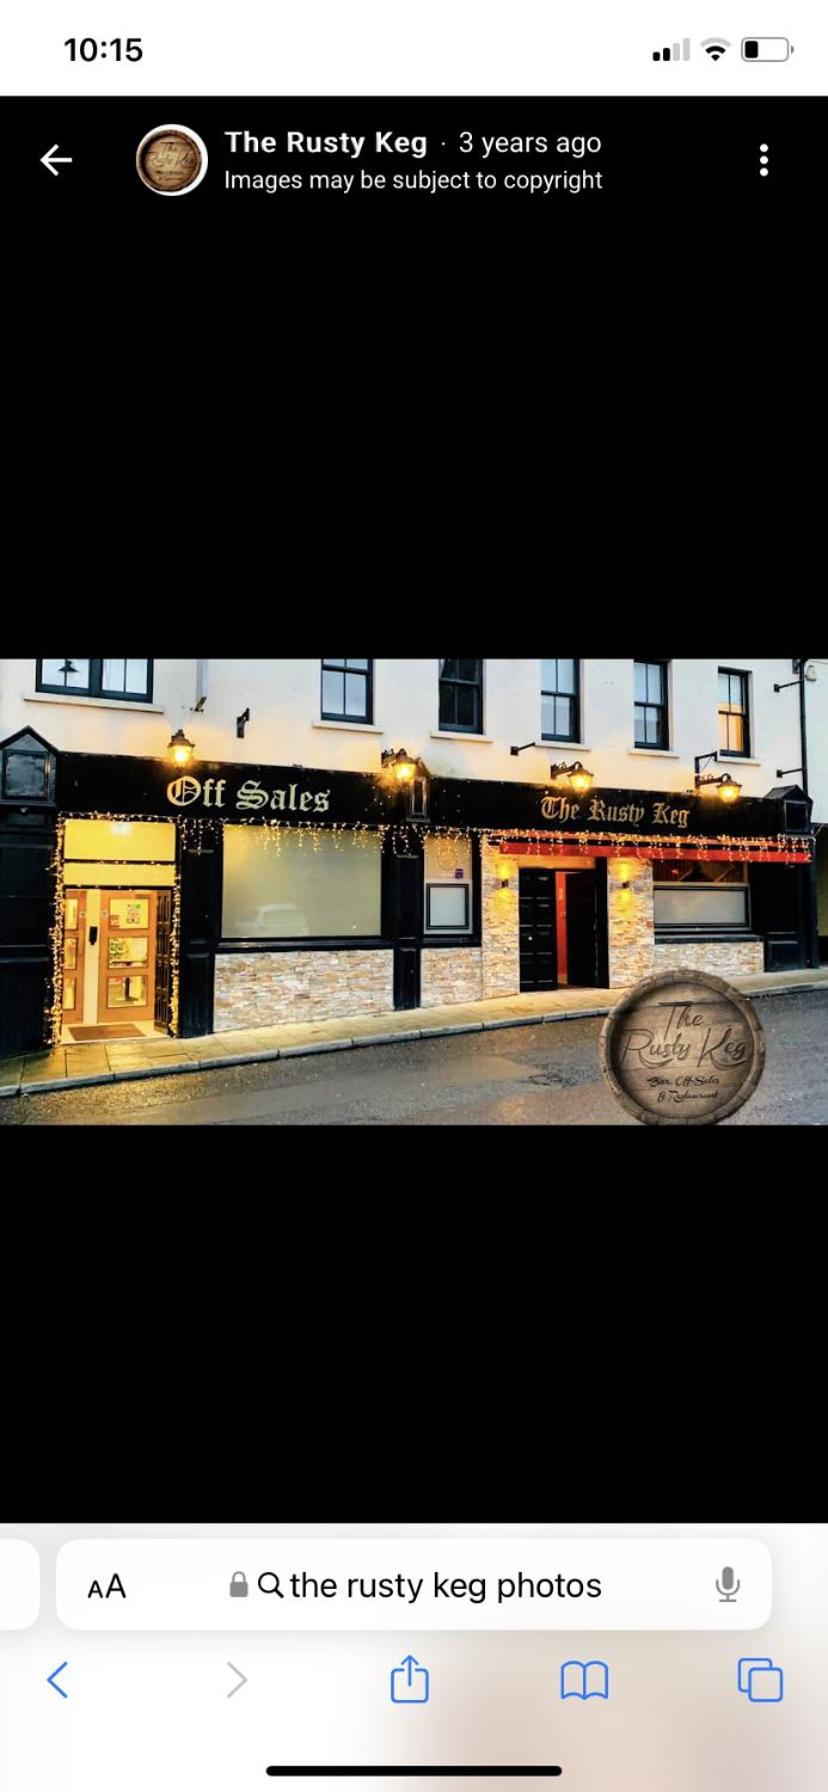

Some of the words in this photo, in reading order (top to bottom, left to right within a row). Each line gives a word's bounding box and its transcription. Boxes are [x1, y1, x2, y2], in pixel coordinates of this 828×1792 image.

[64, 37, 143, 63] 10:15
[223, 130, 277, 154] The
[287, 131, 366, 159] Rusty
[375, 131, 427, 159] Keg
[459, 131, 473, 153] 3
[481, 136, 548, 159] years
[556, 136, 602, 159] ago
[225, 170, 303, 194] Images
[309, 174, 355, 194] may
[360, 169, 386, 189] be
[392, 169, 471, 194] subject
[475, 171, 497, 189] to
[503, 169, 603, 194] copyright
[166, 775, 227, 808] Off
[235, 779, 332, 813] Sales
[540, 796, 580, 823] The
[586, 799, 645, 828] Rusty
[651, 802, 690, 828] Keg
[289, 1571, 338, 1598] the
[348, 1573, 424, 1604] rusty
[434, 1571, 486, 1604] keg
[497, 1571, 602, 1604] photos
